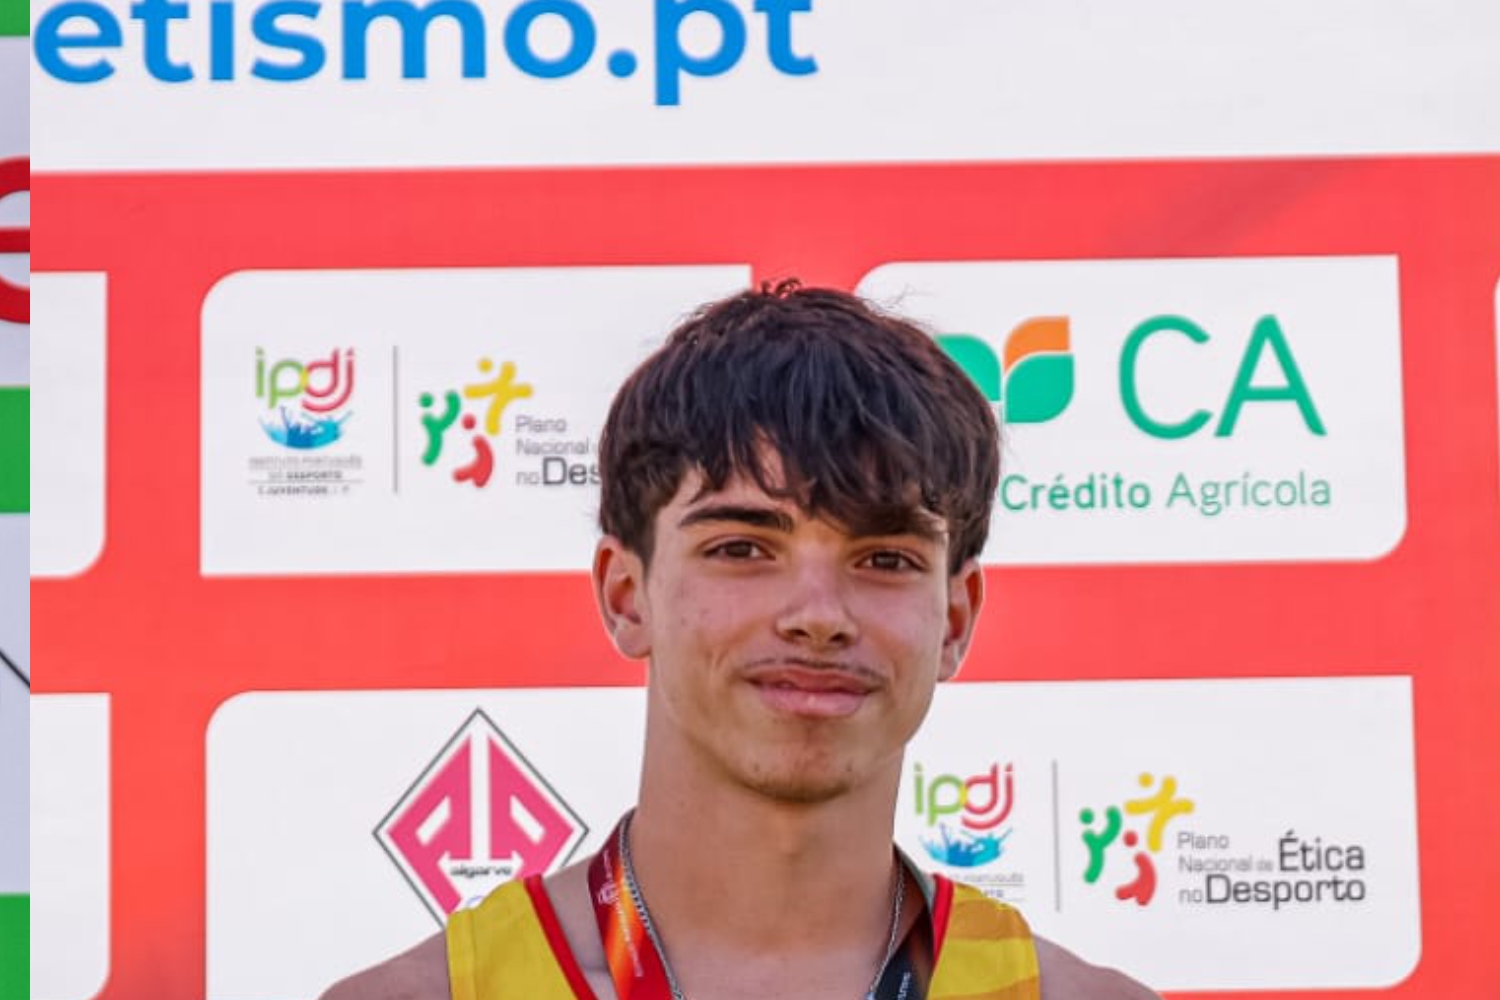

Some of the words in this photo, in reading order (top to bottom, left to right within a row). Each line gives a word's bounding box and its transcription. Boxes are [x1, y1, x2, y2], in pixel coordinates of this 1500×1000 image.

[1118, 313, 1328, 441] CA
[1001, 473, 1151, 512] Crédito
[1166, 471, 1332, 516] Agrícola
[1178, 832, 1230, 850] Plano
[1179, 856, 1254, 873] Nacional
[1279, 828, 1365, 873] Ética
[1179, 888, 1203, 904] no
[1205, 873, 1367, 911] Desporto
